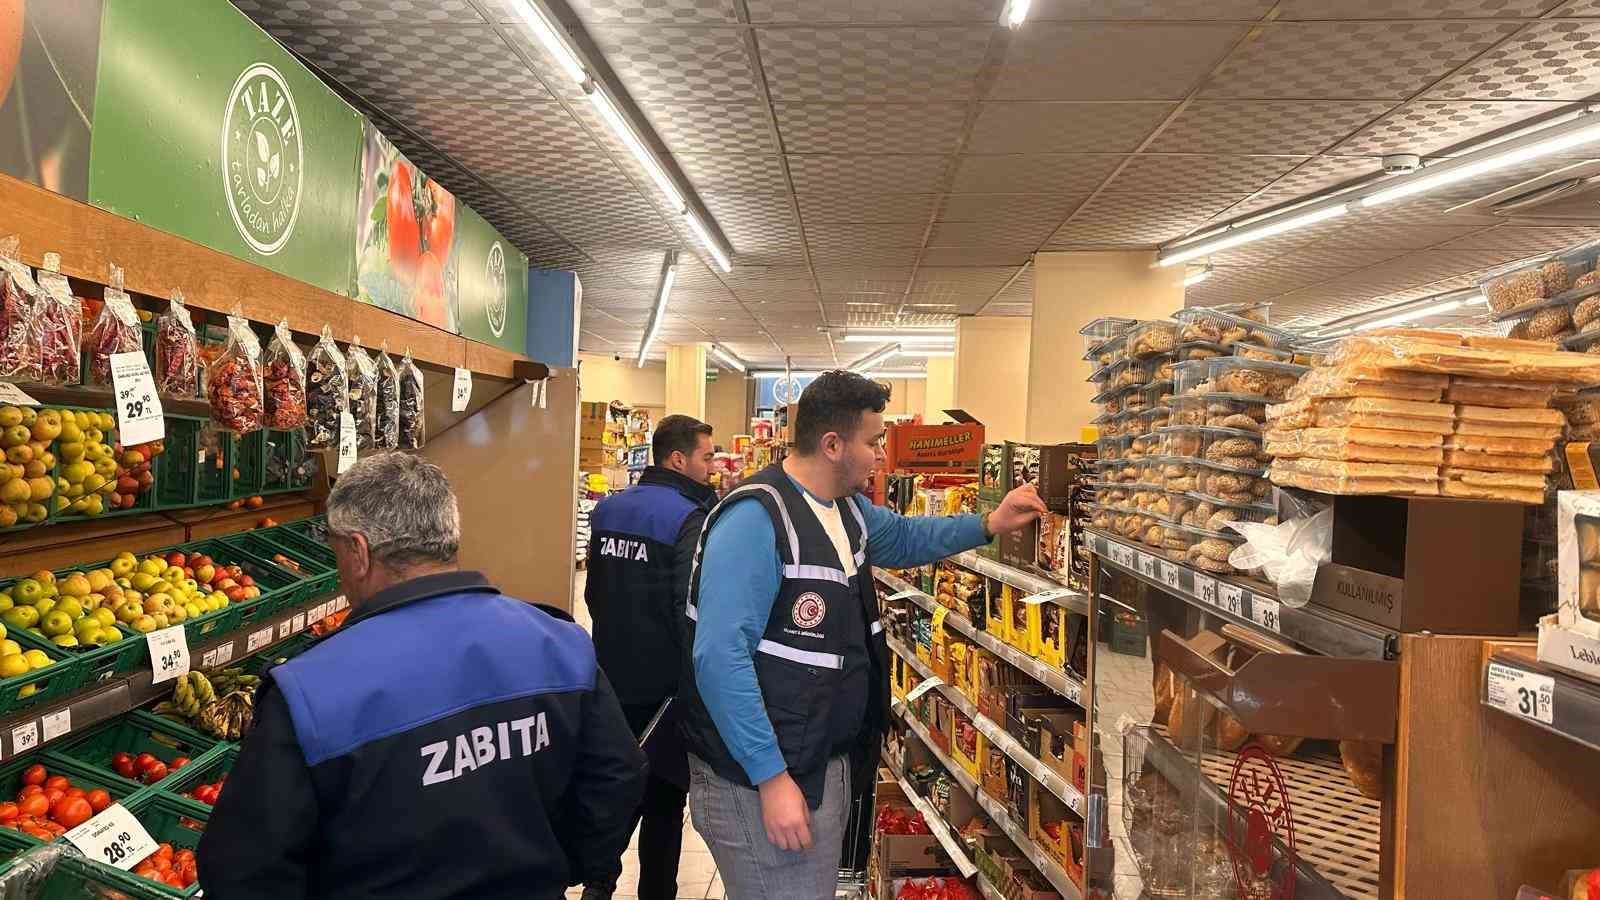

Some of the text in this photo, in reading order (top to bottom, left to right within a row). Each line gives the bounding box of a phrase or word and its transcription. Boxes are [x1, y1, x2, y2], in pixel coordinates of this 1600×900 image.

[241, 81, 296, 147] TAZE
[231, 159, 271, 235] tarladan
[600, 536, 649, 562] ZABITA
[1203, 585, 1211, 602] 29
[1227, 594, 1237, 614] 29
[1263, 609, 1274, 629] 39
[21, 734, 31, 745] 39
[420, 711, 550, 786] ZABITA
